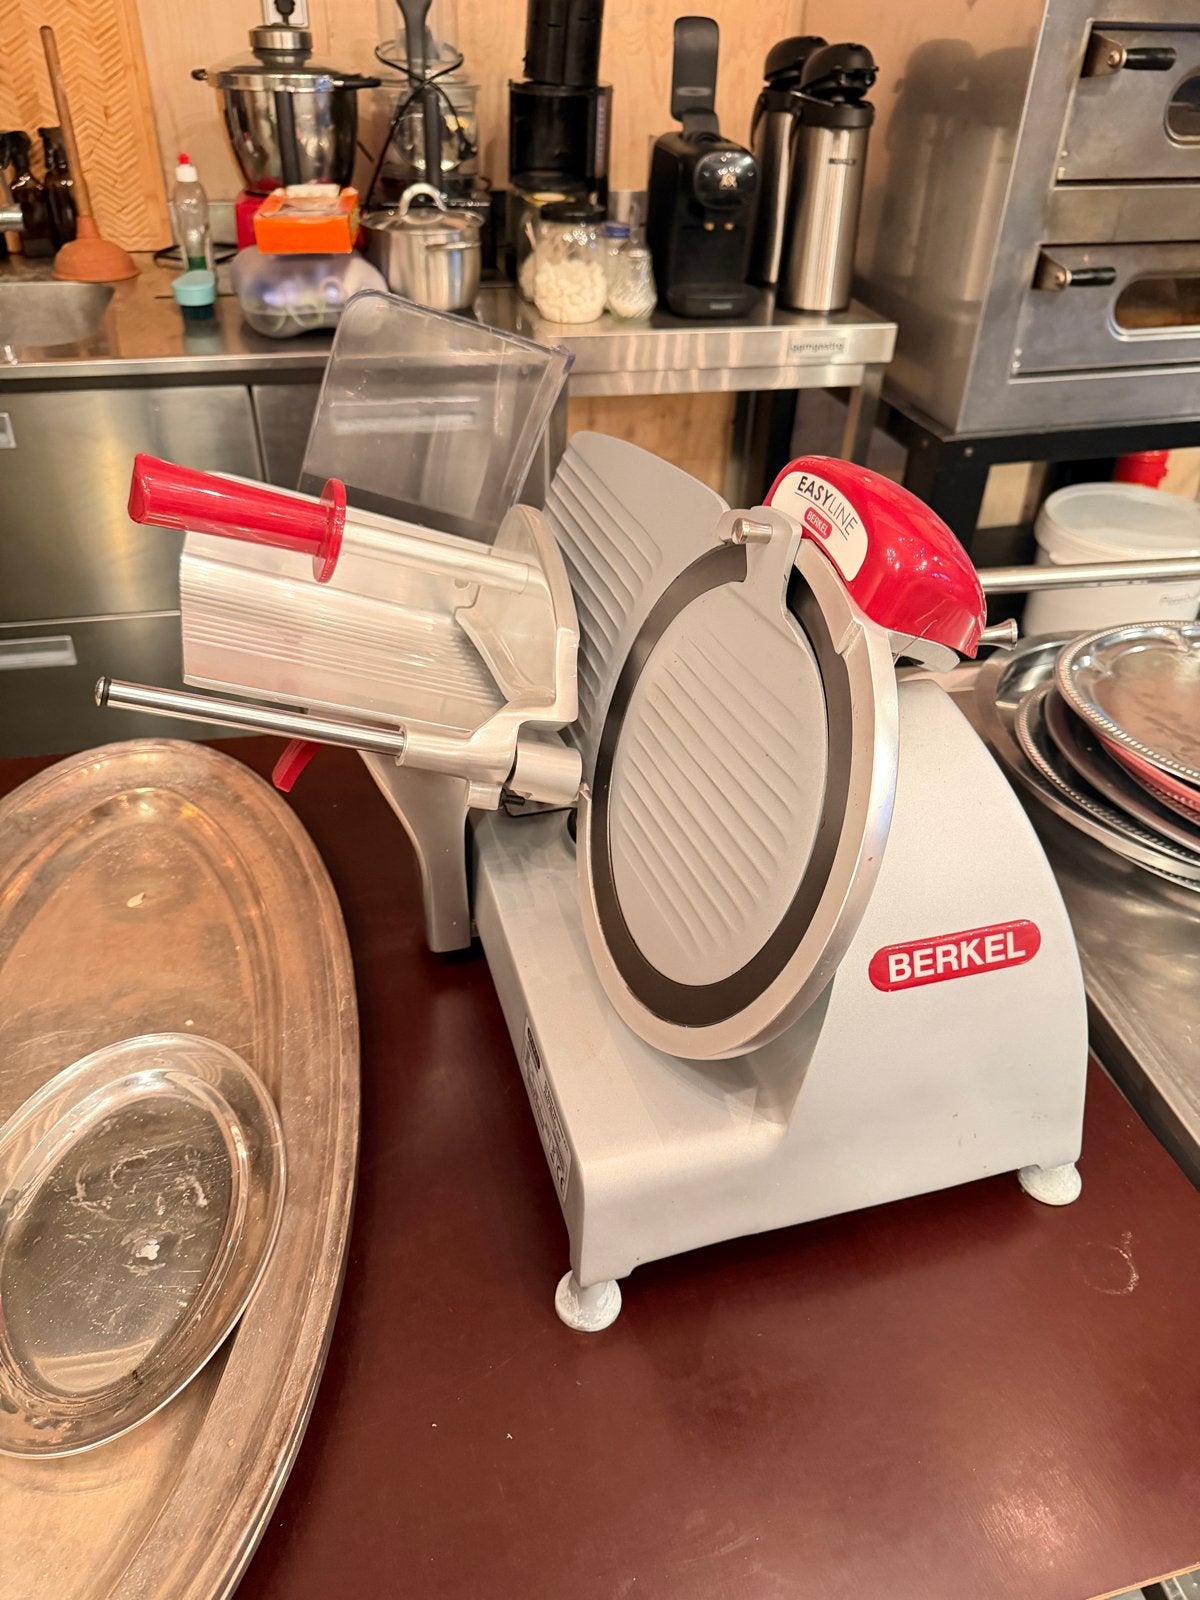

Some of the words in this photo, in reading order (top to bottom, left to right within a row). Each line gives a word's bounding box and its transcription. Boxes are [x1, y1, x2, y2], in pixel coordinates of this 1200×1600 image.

[797, 475, 858, 536] EASYLINE
[806, 510, 829, 536] BERKEL
[888, 931, 1026, 983] BERKEL
